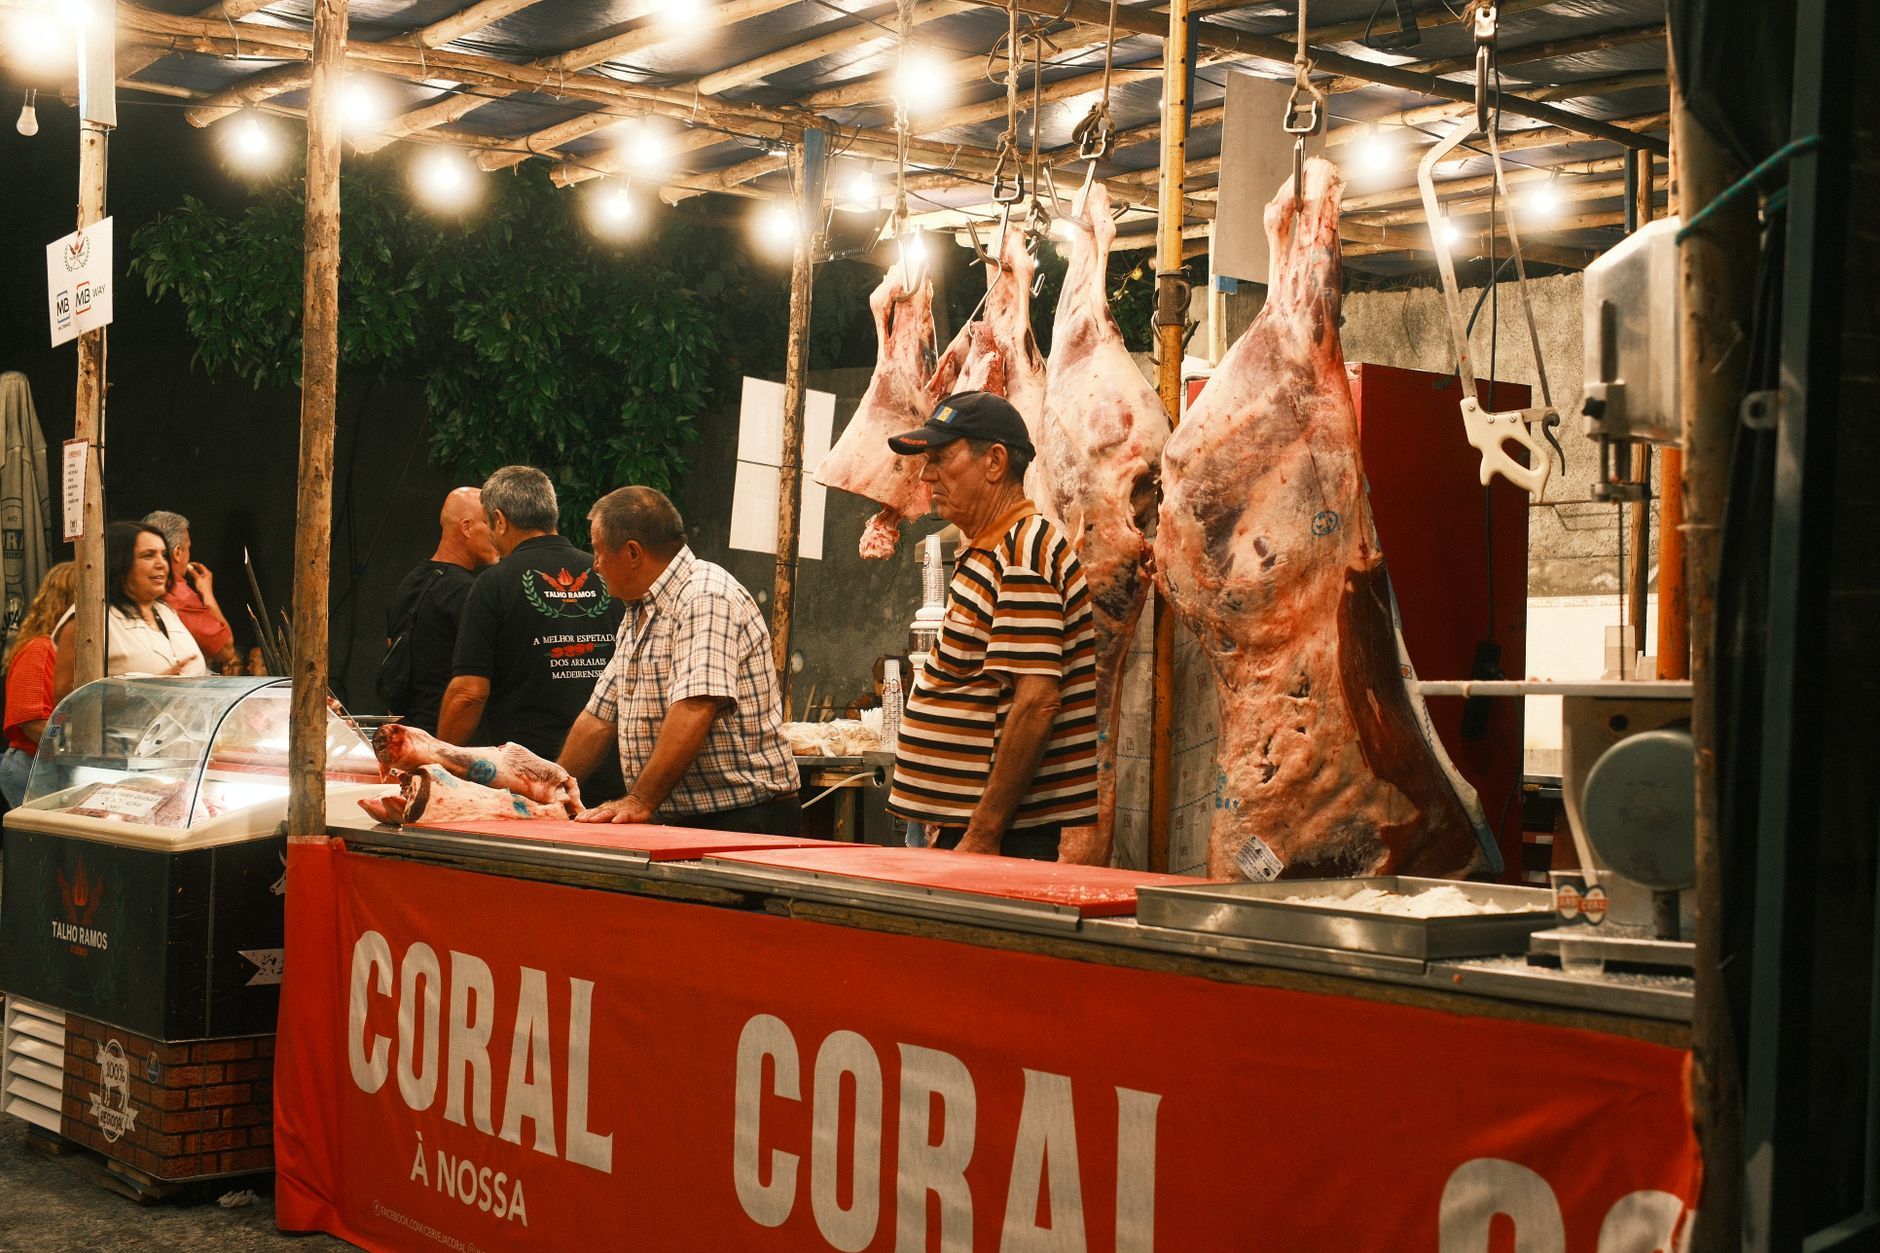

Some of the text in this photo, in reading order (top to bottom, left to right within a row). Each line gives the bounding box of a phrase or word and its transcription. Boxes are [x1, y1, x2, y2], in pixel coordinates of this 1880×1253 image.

[76, 284, 105, 307] MB WAY
[57, 298, 69, 316] MB
[533, 637, 541, 646] A
[543, 635, 575, 644] MELHOR
[550, 657, 607, 667] DOS ARRAIAIS
[52, 921, 108, 950] TALHO RAMOS
[349, 930, 613, 1174] CORAL
[106, 1061, 126, 1083] 100%
[410, 1131, 528, 1227] À NOSSA
